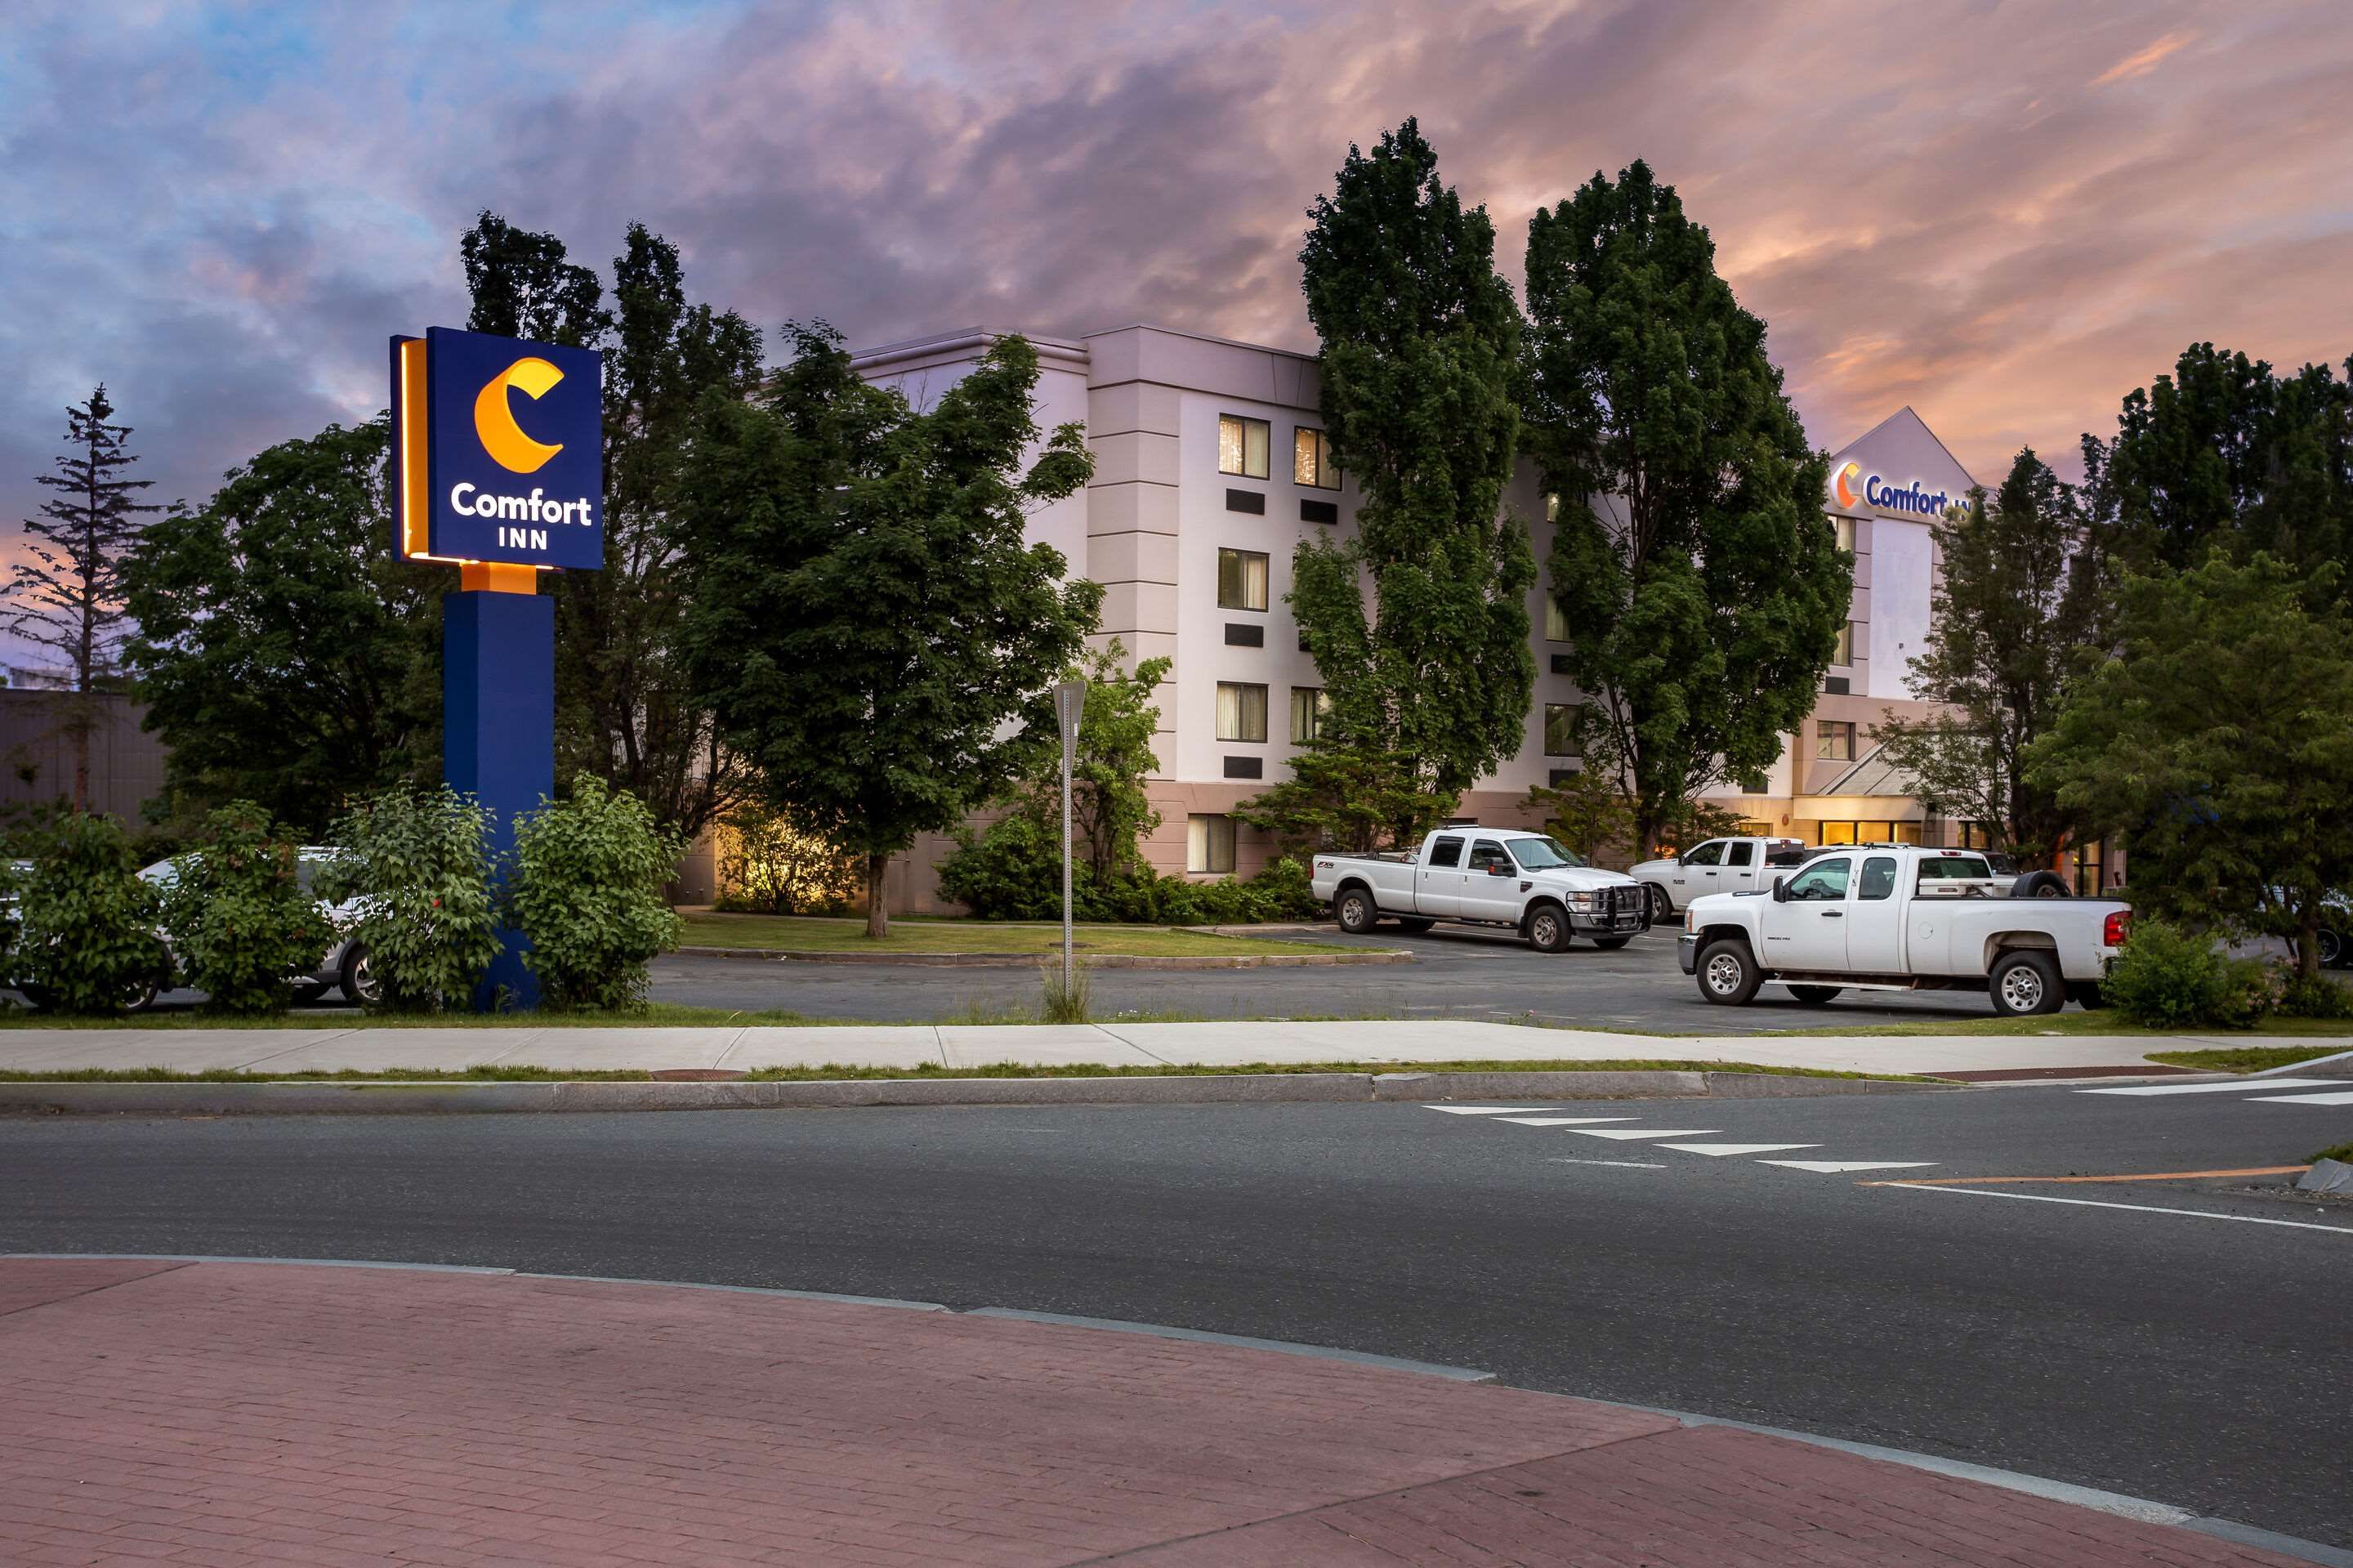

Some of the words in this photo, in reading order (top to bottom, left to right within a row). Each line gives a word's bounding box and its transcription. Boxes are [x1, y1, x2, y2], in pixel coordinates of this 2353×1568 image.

[451, 483, 592, 526] Comfort
[1864, 476, 1947, 518] Comfort
[498, 527, 547, 550] INN
